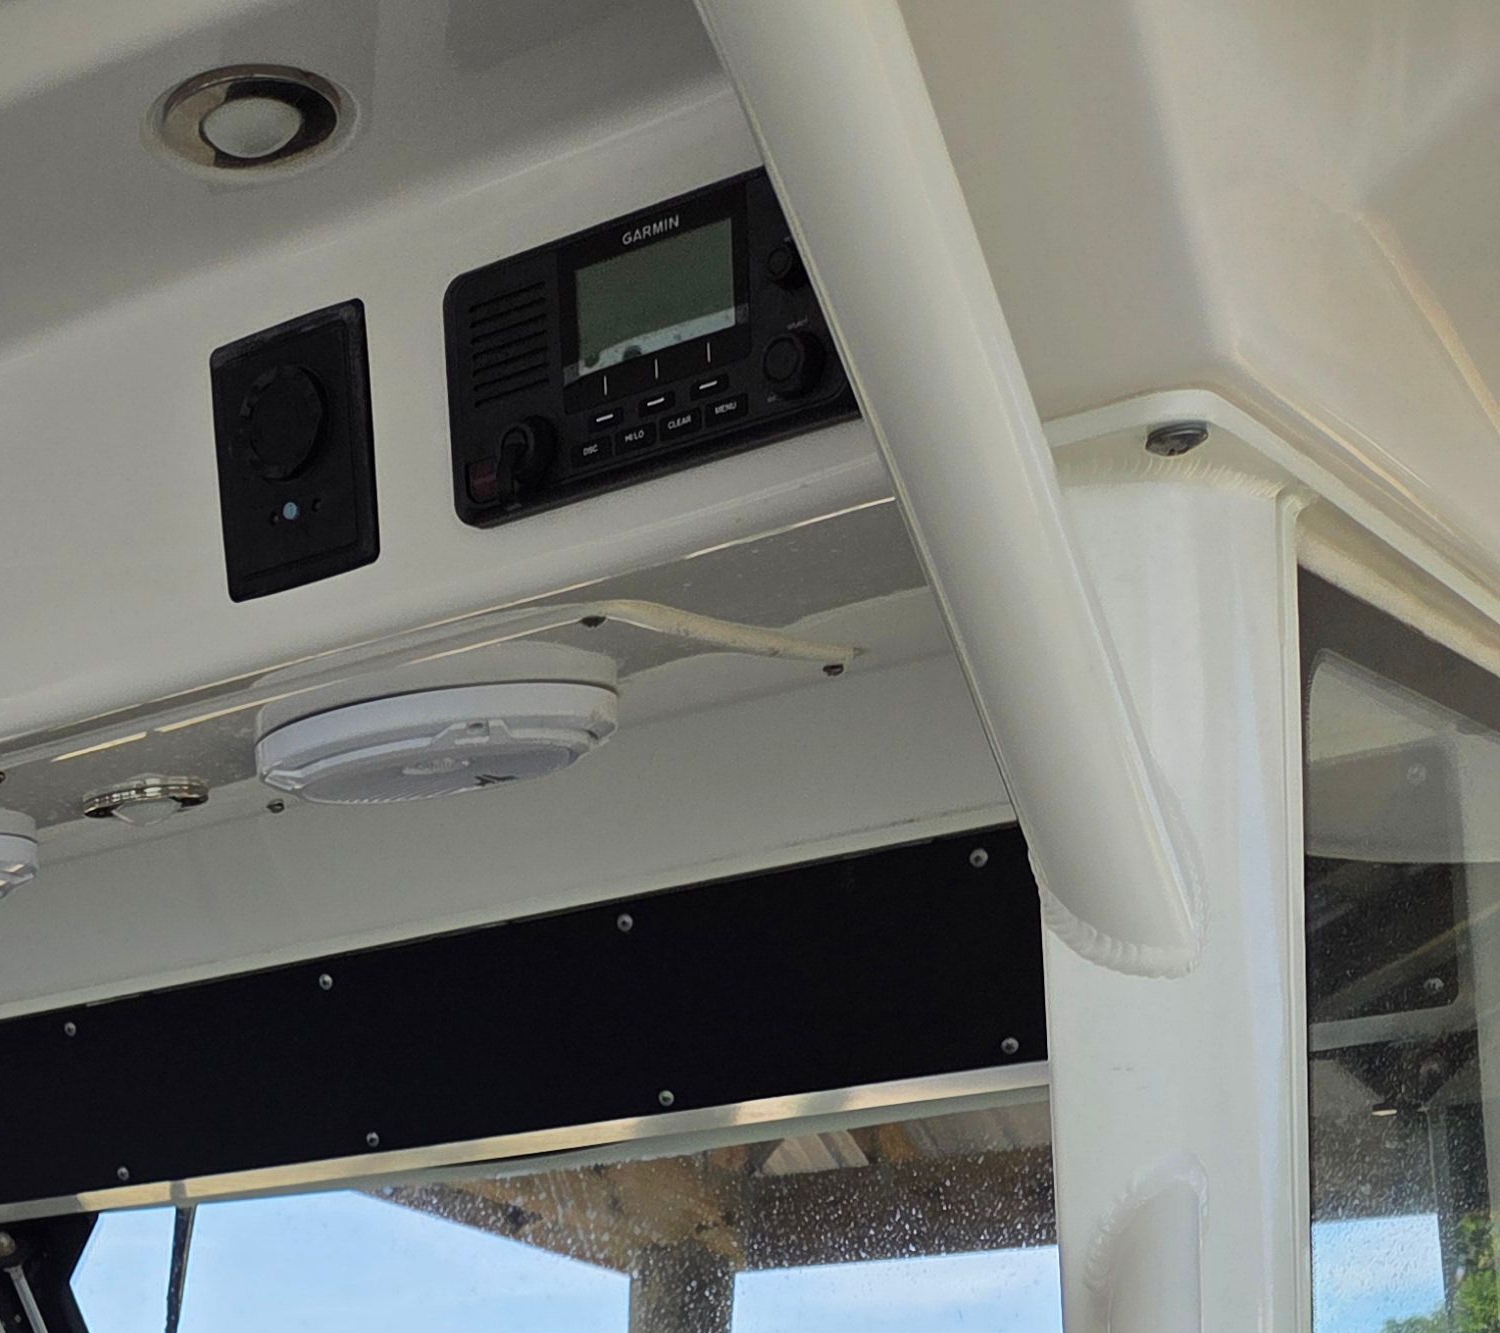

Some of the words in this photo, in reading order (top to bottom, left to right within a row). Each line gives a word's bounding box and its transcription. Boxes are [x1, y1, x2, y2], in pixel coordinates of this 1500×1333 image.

[621, 214, 680, 246] GARMIN
[714, 402, 738, 416] MENU
[667, 414, 693, 430] CLEAR
[582, 444, 599, 457] DSC
